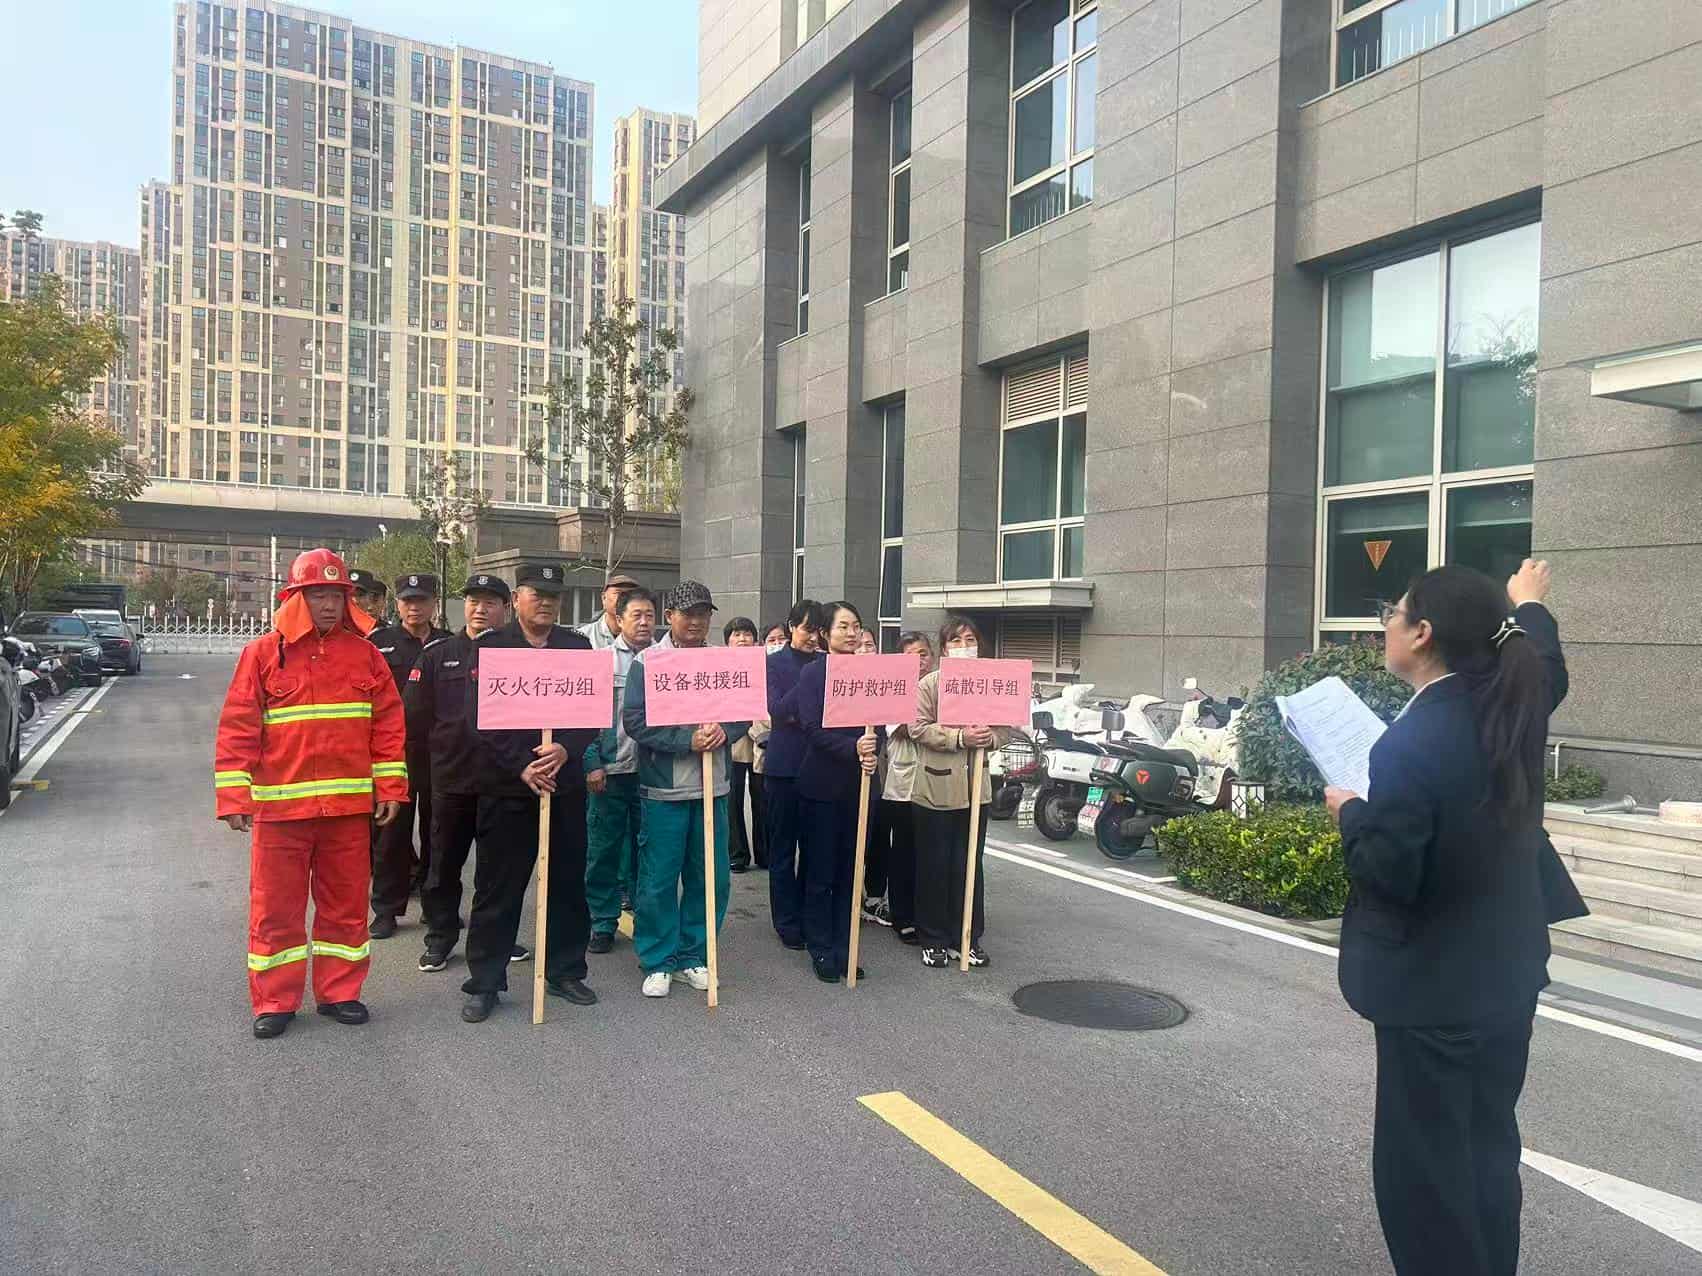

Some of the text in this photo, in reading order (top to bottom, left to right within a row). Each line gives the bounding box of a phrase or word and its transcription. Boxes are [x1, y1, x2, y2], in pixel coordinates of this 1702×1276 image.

[487, 676, 596, 697] 灭火行动组
[653, 670, 752, 692] 设备救援组
[832, 679, 907, 697] 防护救护组
[944, 678, 1019, 696] 疏散引导组
